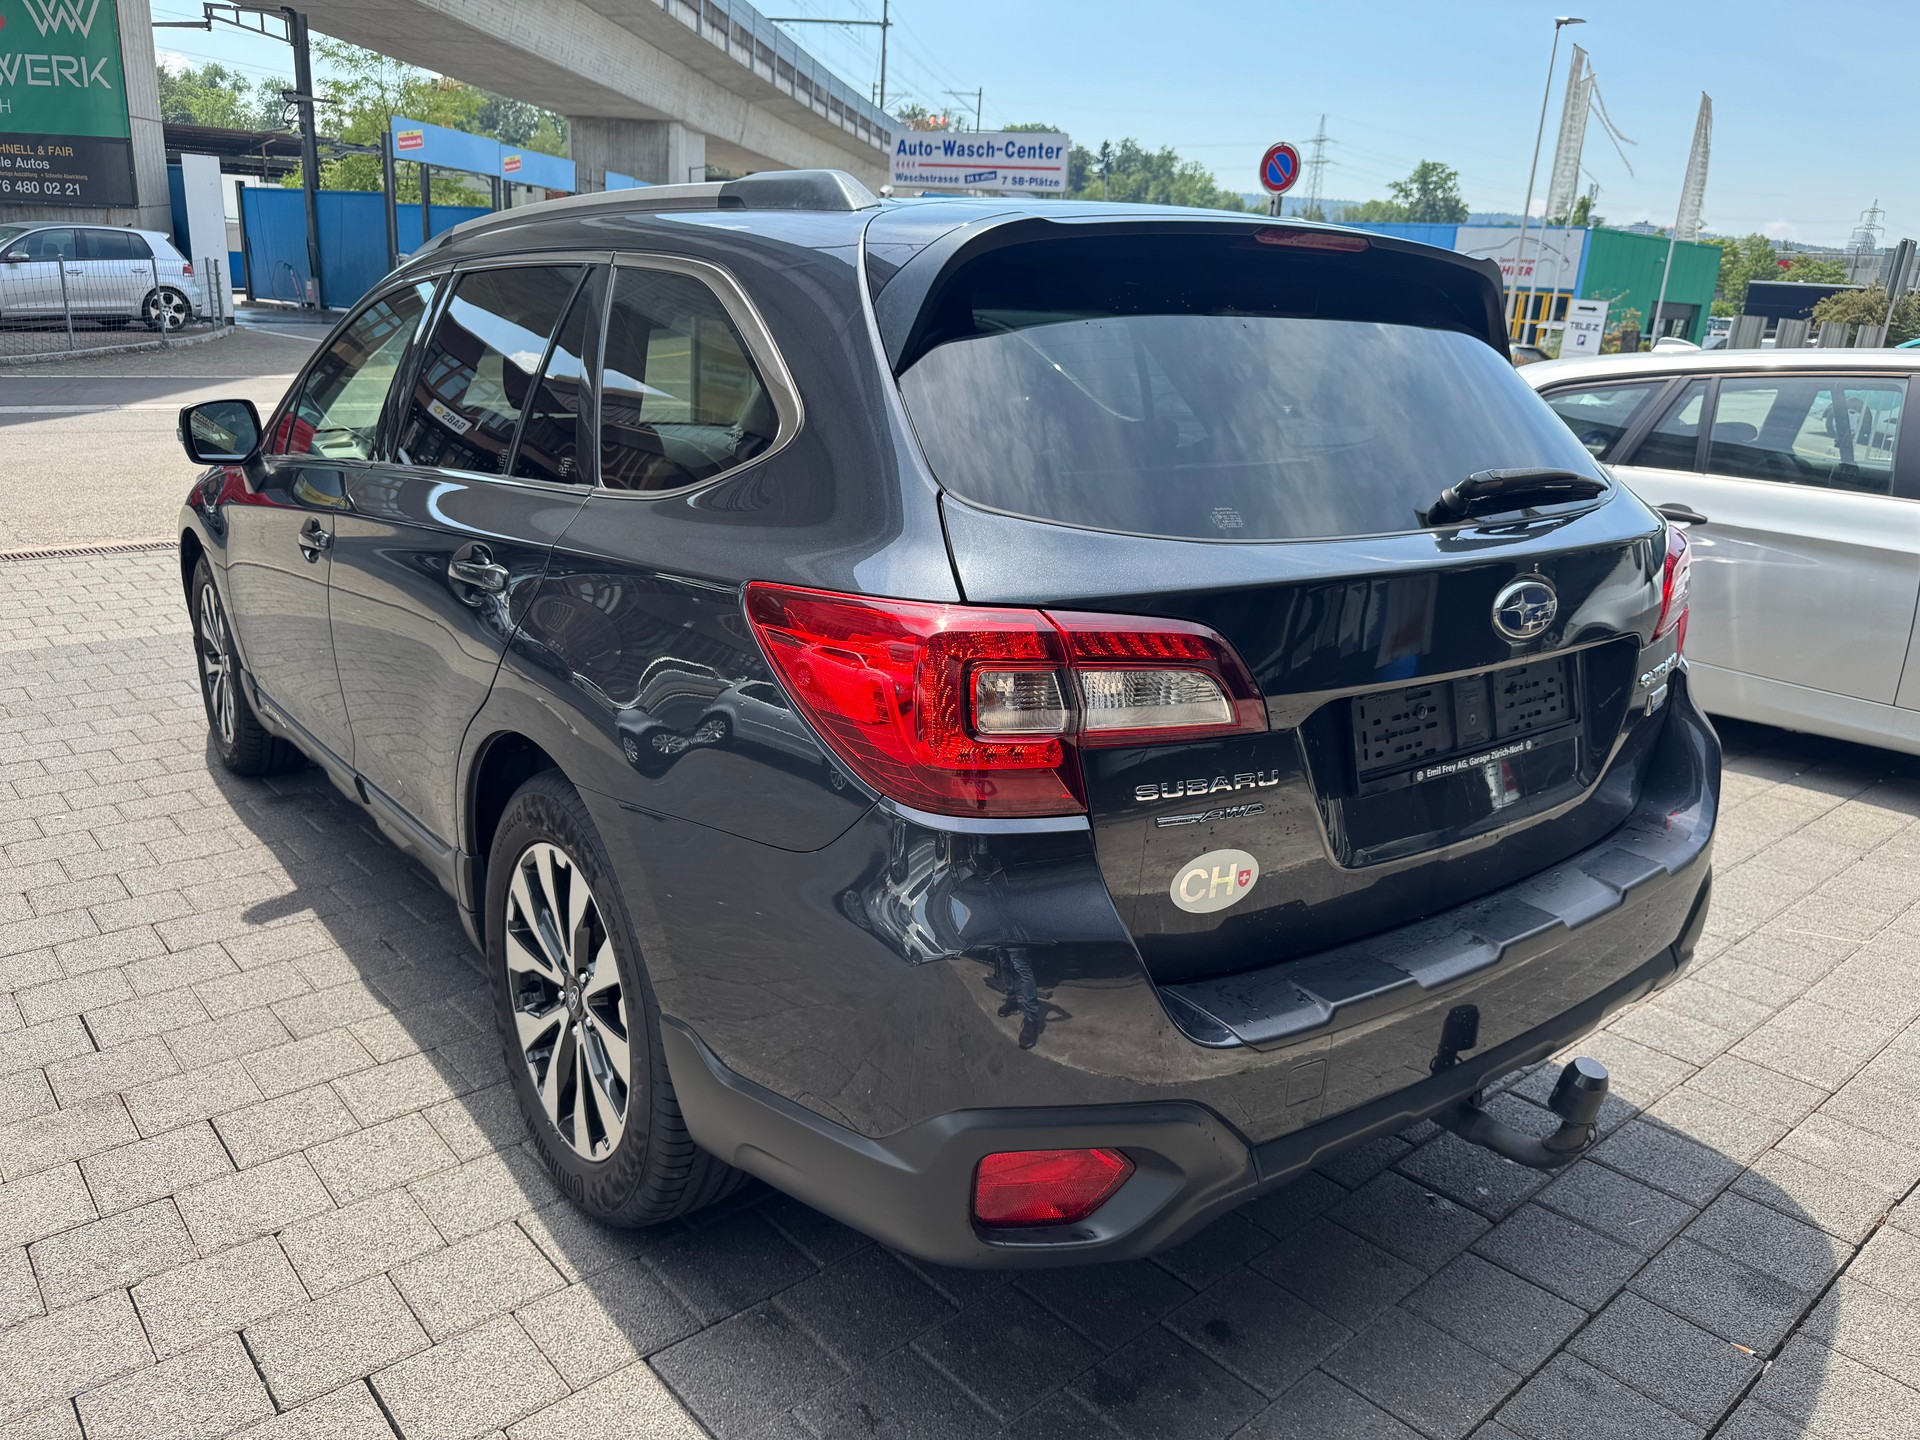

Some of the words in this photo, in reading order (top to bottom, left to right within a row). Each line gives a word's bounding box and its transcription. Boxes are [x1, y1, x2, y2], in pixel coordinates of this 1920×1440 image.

[37, 145, 45, 156] &
[48, 145, 74, 157] FAIR
[896, 139, 1063, 160] Auto-Wasch-Center
[0, 156, 12, 168] le
[15, 157, 50, 170] Autos
[0, 180, 11, 193] 6
[15, 181, 40, 194] 480
[43, 182, 61, 195] 02
[65, 182, 81, 196] 21
[895, 172, 960, 184] Waschstrasse
[1001, 176, 1008, 185] 7
[1426, 766, 1442, 778] Emil
[1442, 764, 1457, 774] Frey
[1457, 760, 1469, 770] AG,
[1469, 753, 1491, 766] Garage
[1491, 742, 1524, 760] Zürich-Nord
[1134, 769, 1279, 801] SUBARU
[1200, 803, 1267, 823] AWD
[1179, 863, 1238, 903] CH
